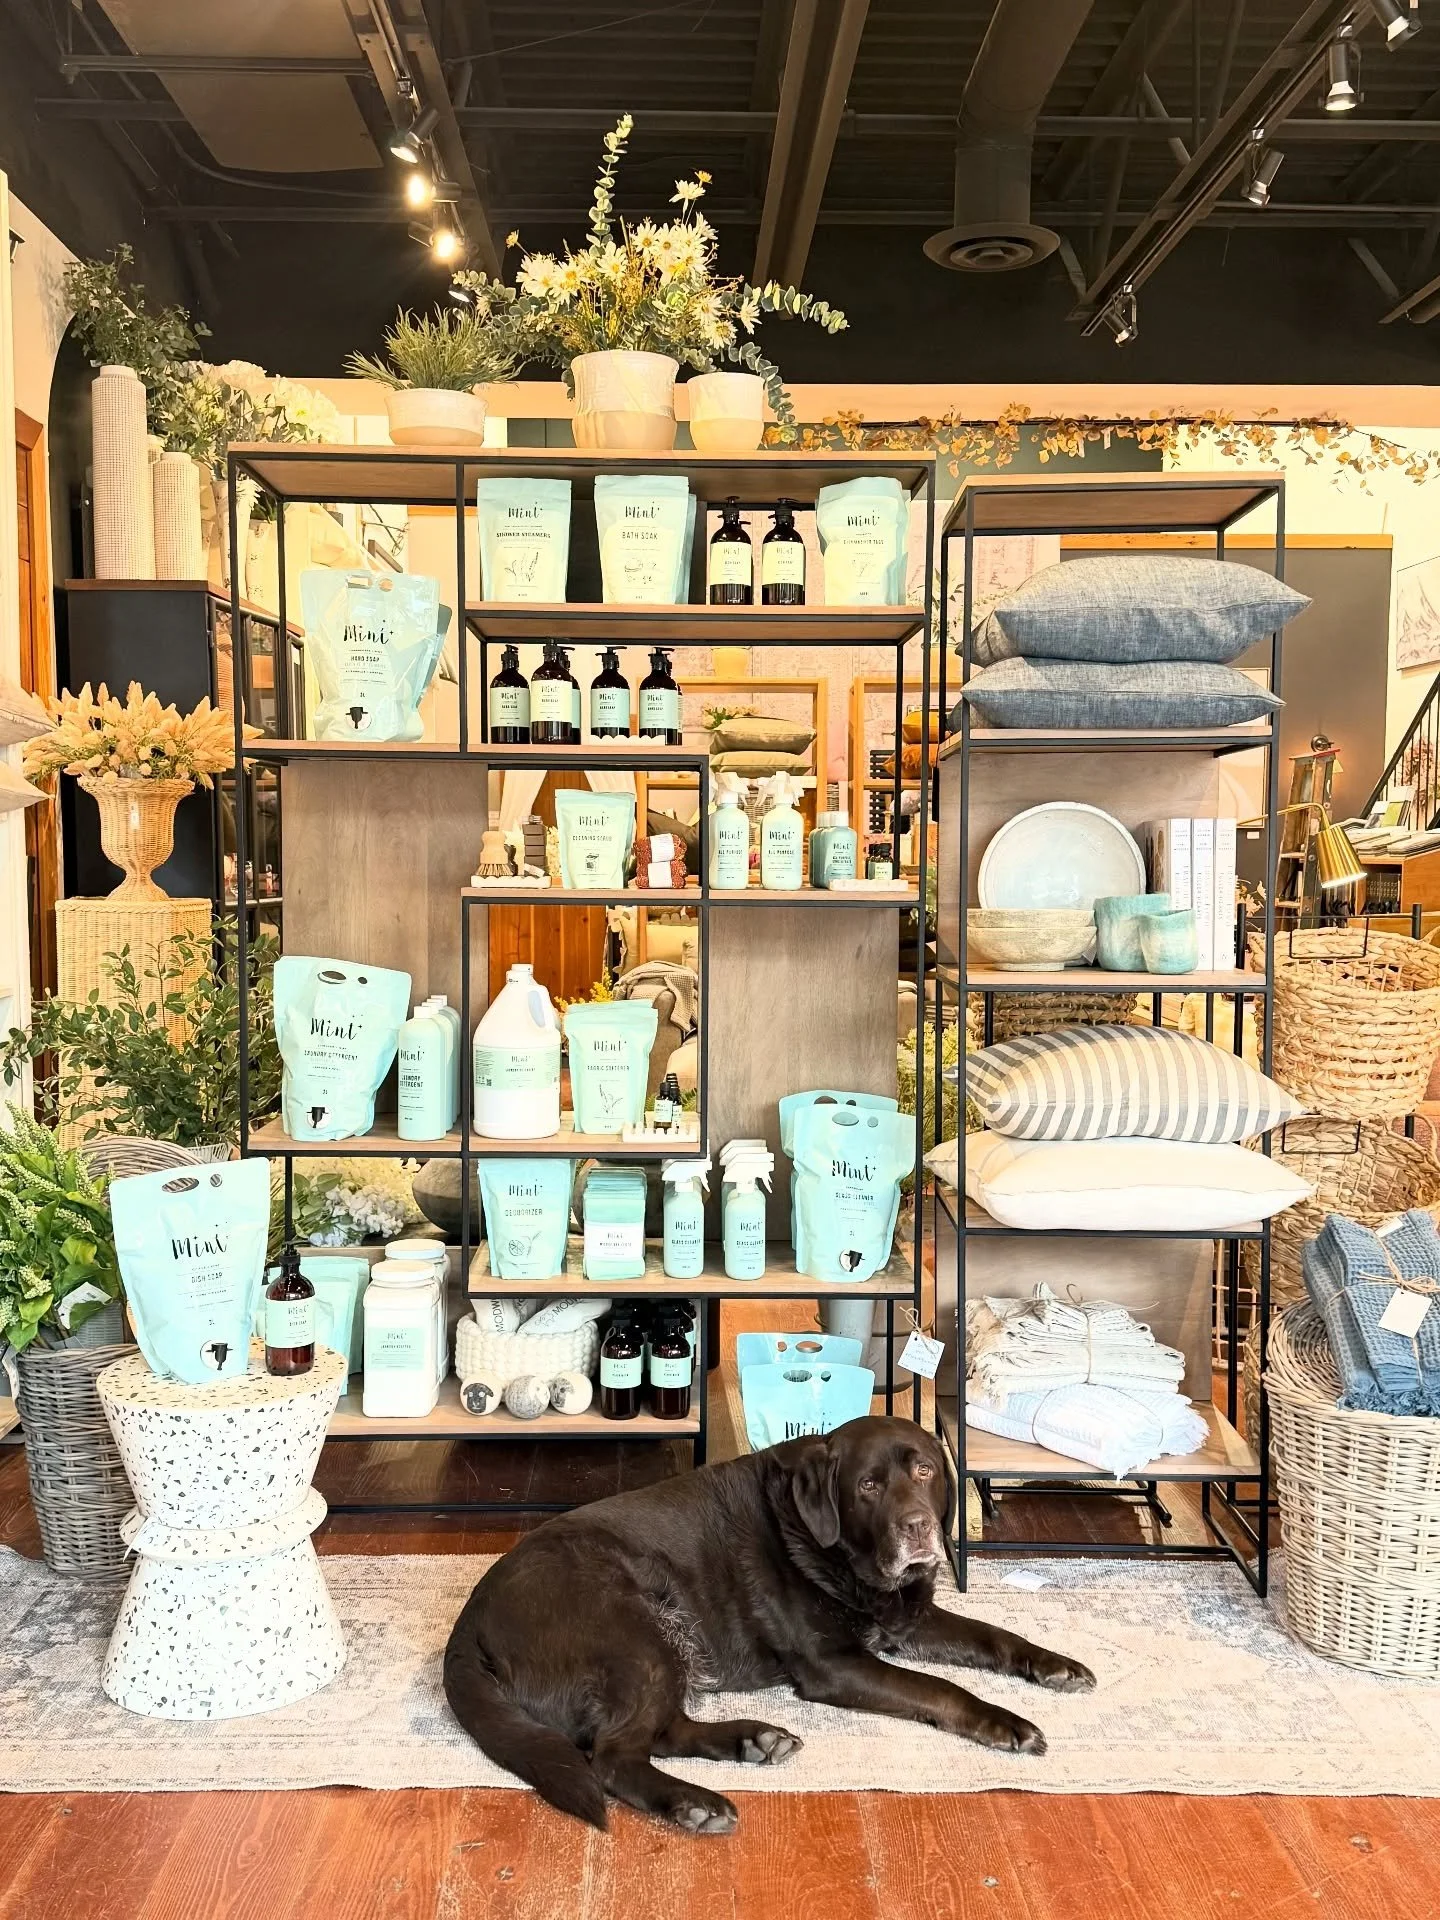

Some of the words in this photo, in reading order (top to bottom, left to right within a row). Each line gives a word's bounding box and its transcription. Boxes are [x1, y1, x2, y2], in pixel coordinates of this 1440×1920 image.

[508, 505, 542, 519] Mint
[625, 504, 658, 519] Mint
[847, 514, 879, 527] Mint
[622, 531, 639, 540] BATH
[641, 531, 658, 540] SOAK
[343, 622, 391, 645] Mint
[310, 1017, 360, 1041] Mint
[832, 1158, 876, 1182] Mint
[172, 1232, 228, 1260] Mint
[191, 1275, 206, 1283] DISH
[490, 1298, 505, 1334] MODW
